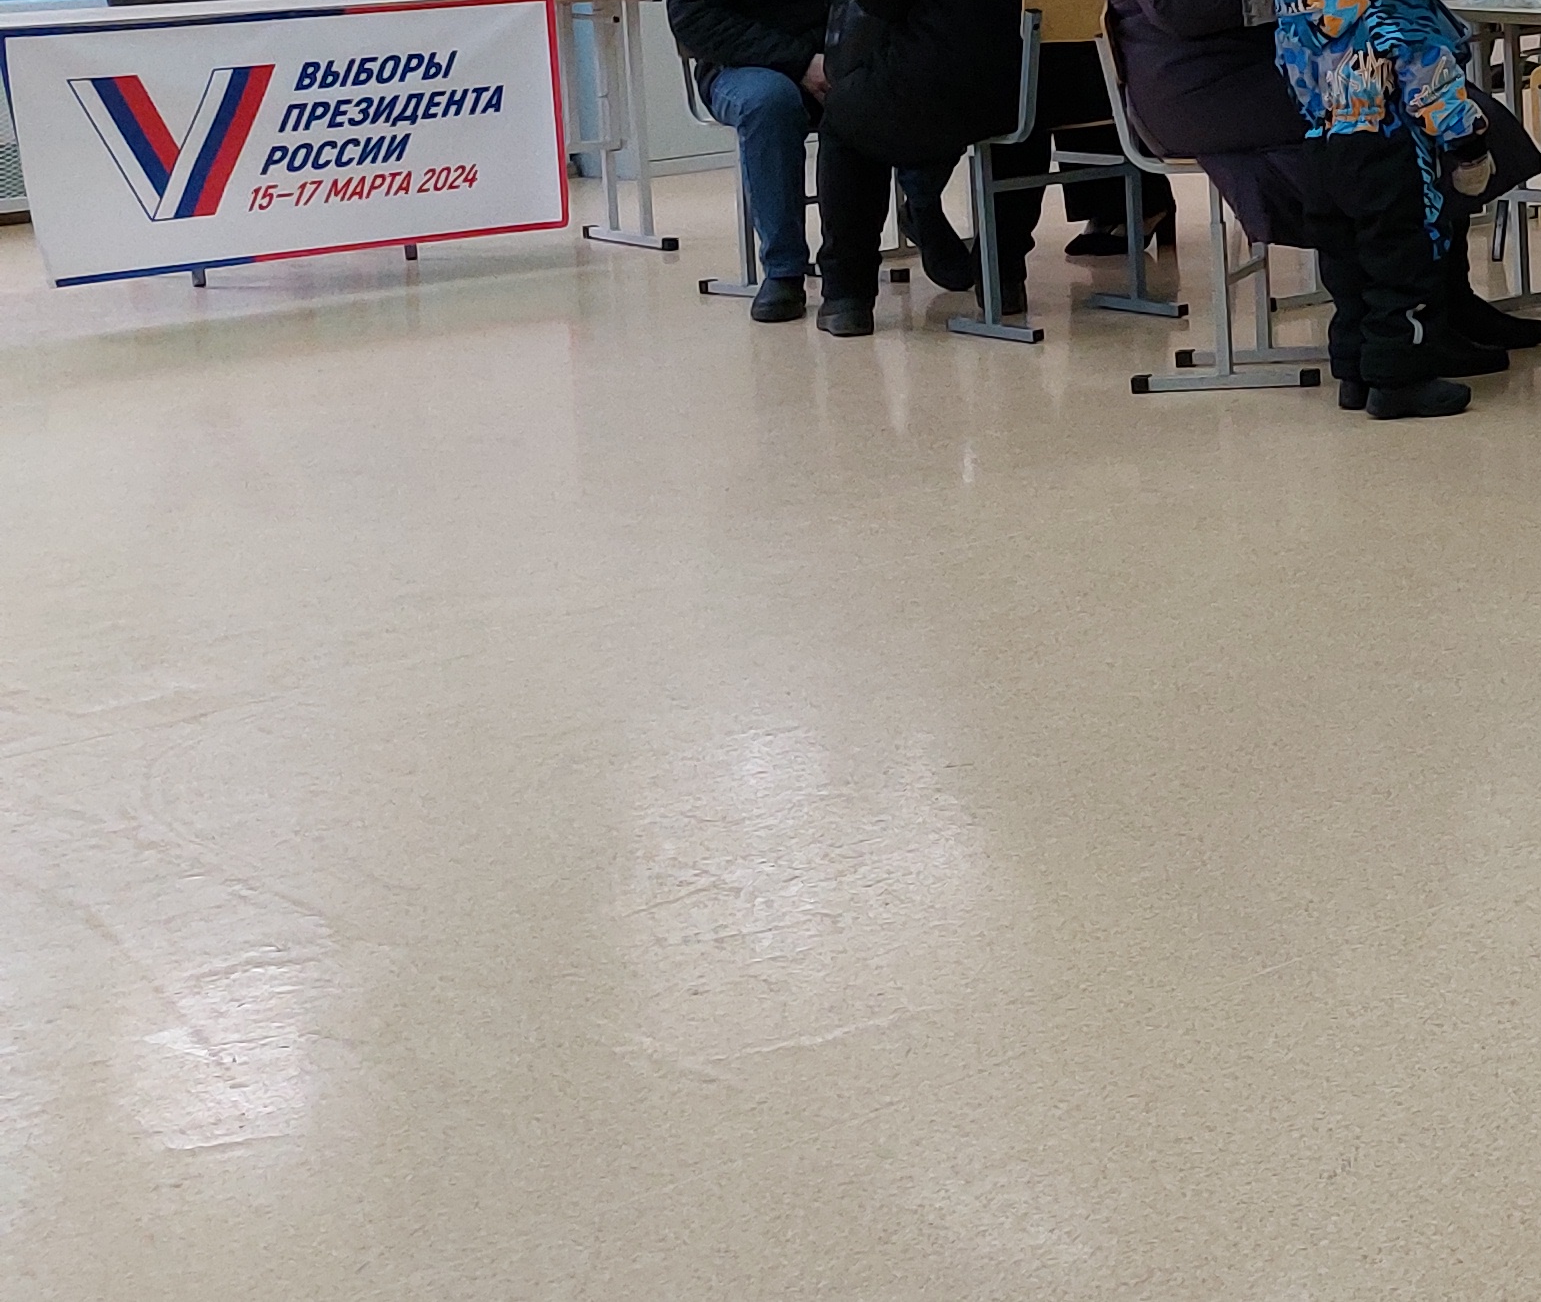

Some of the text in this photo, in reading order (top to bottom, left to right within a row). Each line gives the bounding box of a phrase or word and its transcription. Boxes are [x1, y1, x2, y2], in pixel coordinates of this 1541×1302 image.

[294, 50, 458, 91] ВЫБОРЫ
[278, 85, 504, 133] ПРЕЗИДЕНТА
[260, 133, 411, 175] РОССИИ
[324, 170, 412, 203] МАРТА
[417, 163, 478, 193] 2024
